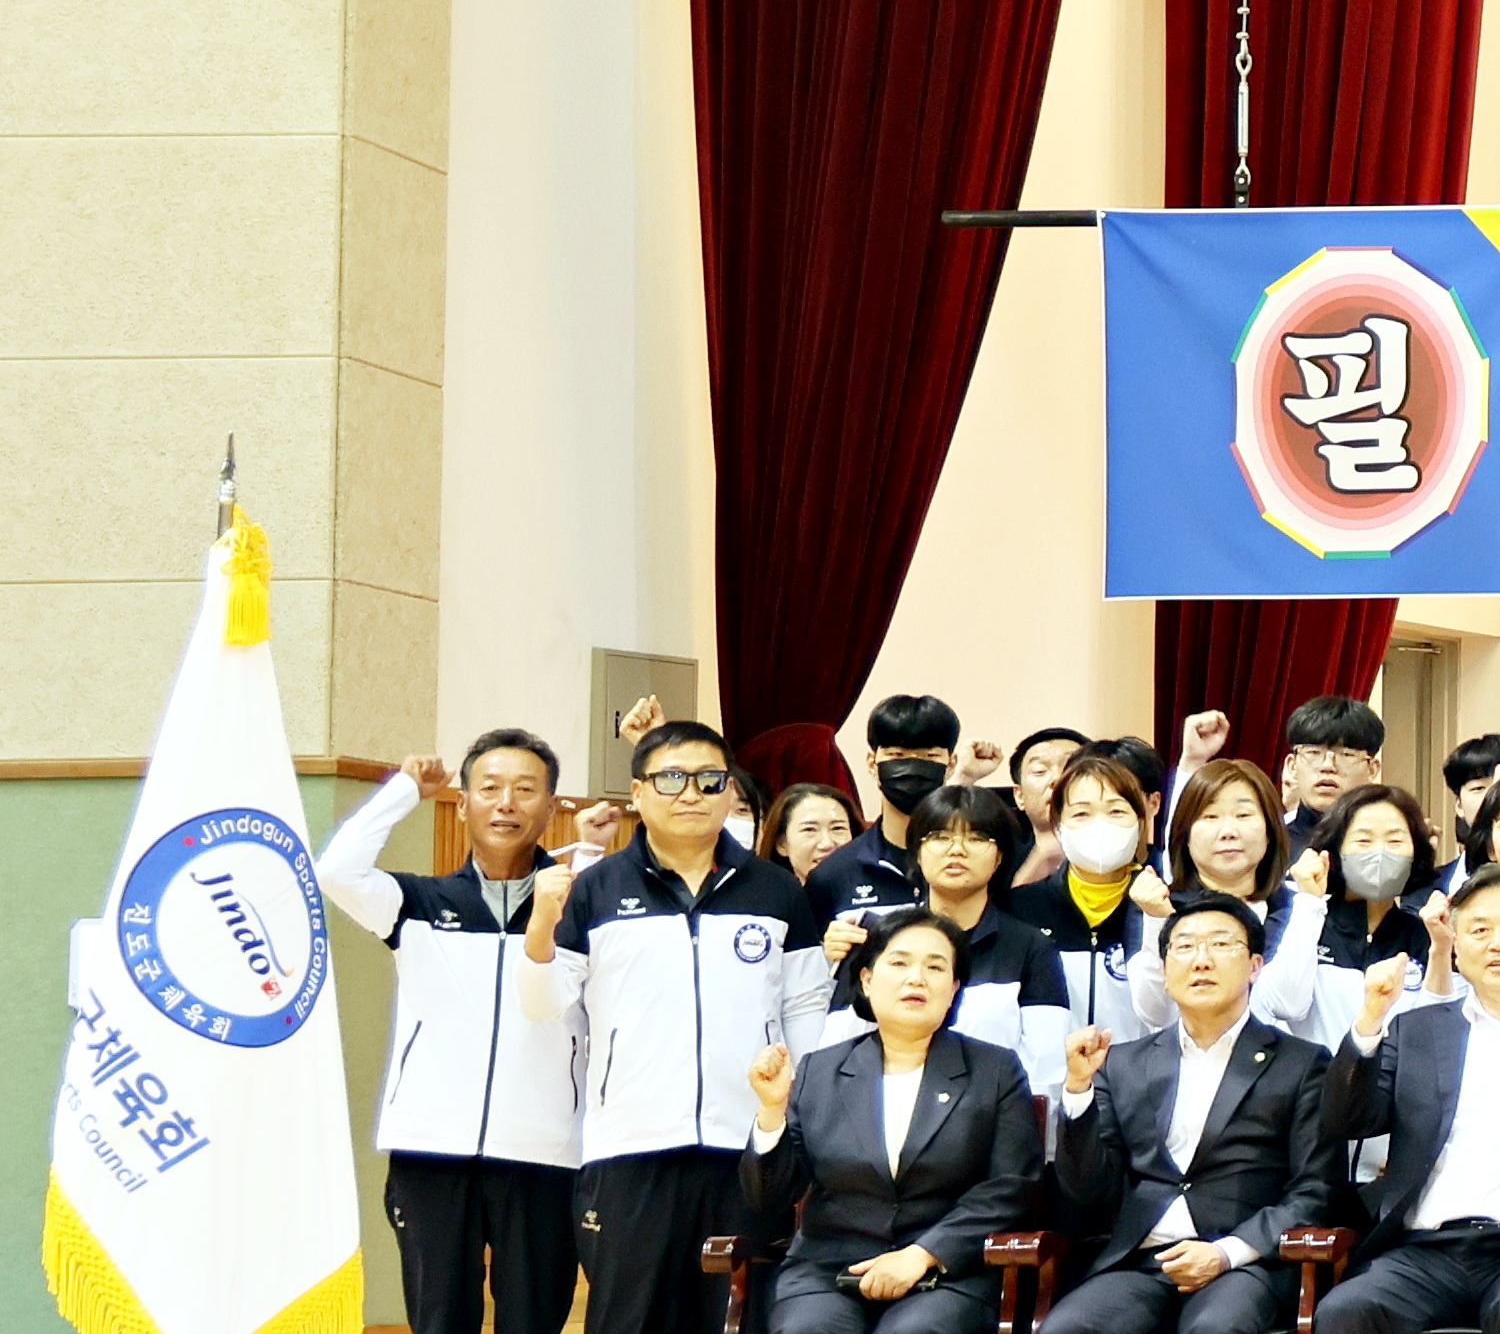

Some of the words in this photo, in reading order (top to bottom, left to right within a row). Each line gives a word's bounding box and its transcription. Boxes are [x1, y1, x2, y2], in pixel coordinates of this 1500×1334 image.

[1281, 314, 1422, 494] 필
[199, 814, 295, 853] Jindogun
[189, 872, 271, 976] Jindo
[294, 852, 322, 931] Sports
[123, 901, 232, 1042] 진도군체육회
[295, 936, 327, 1020] Council
[79, 1113, 149, 1194] Council
